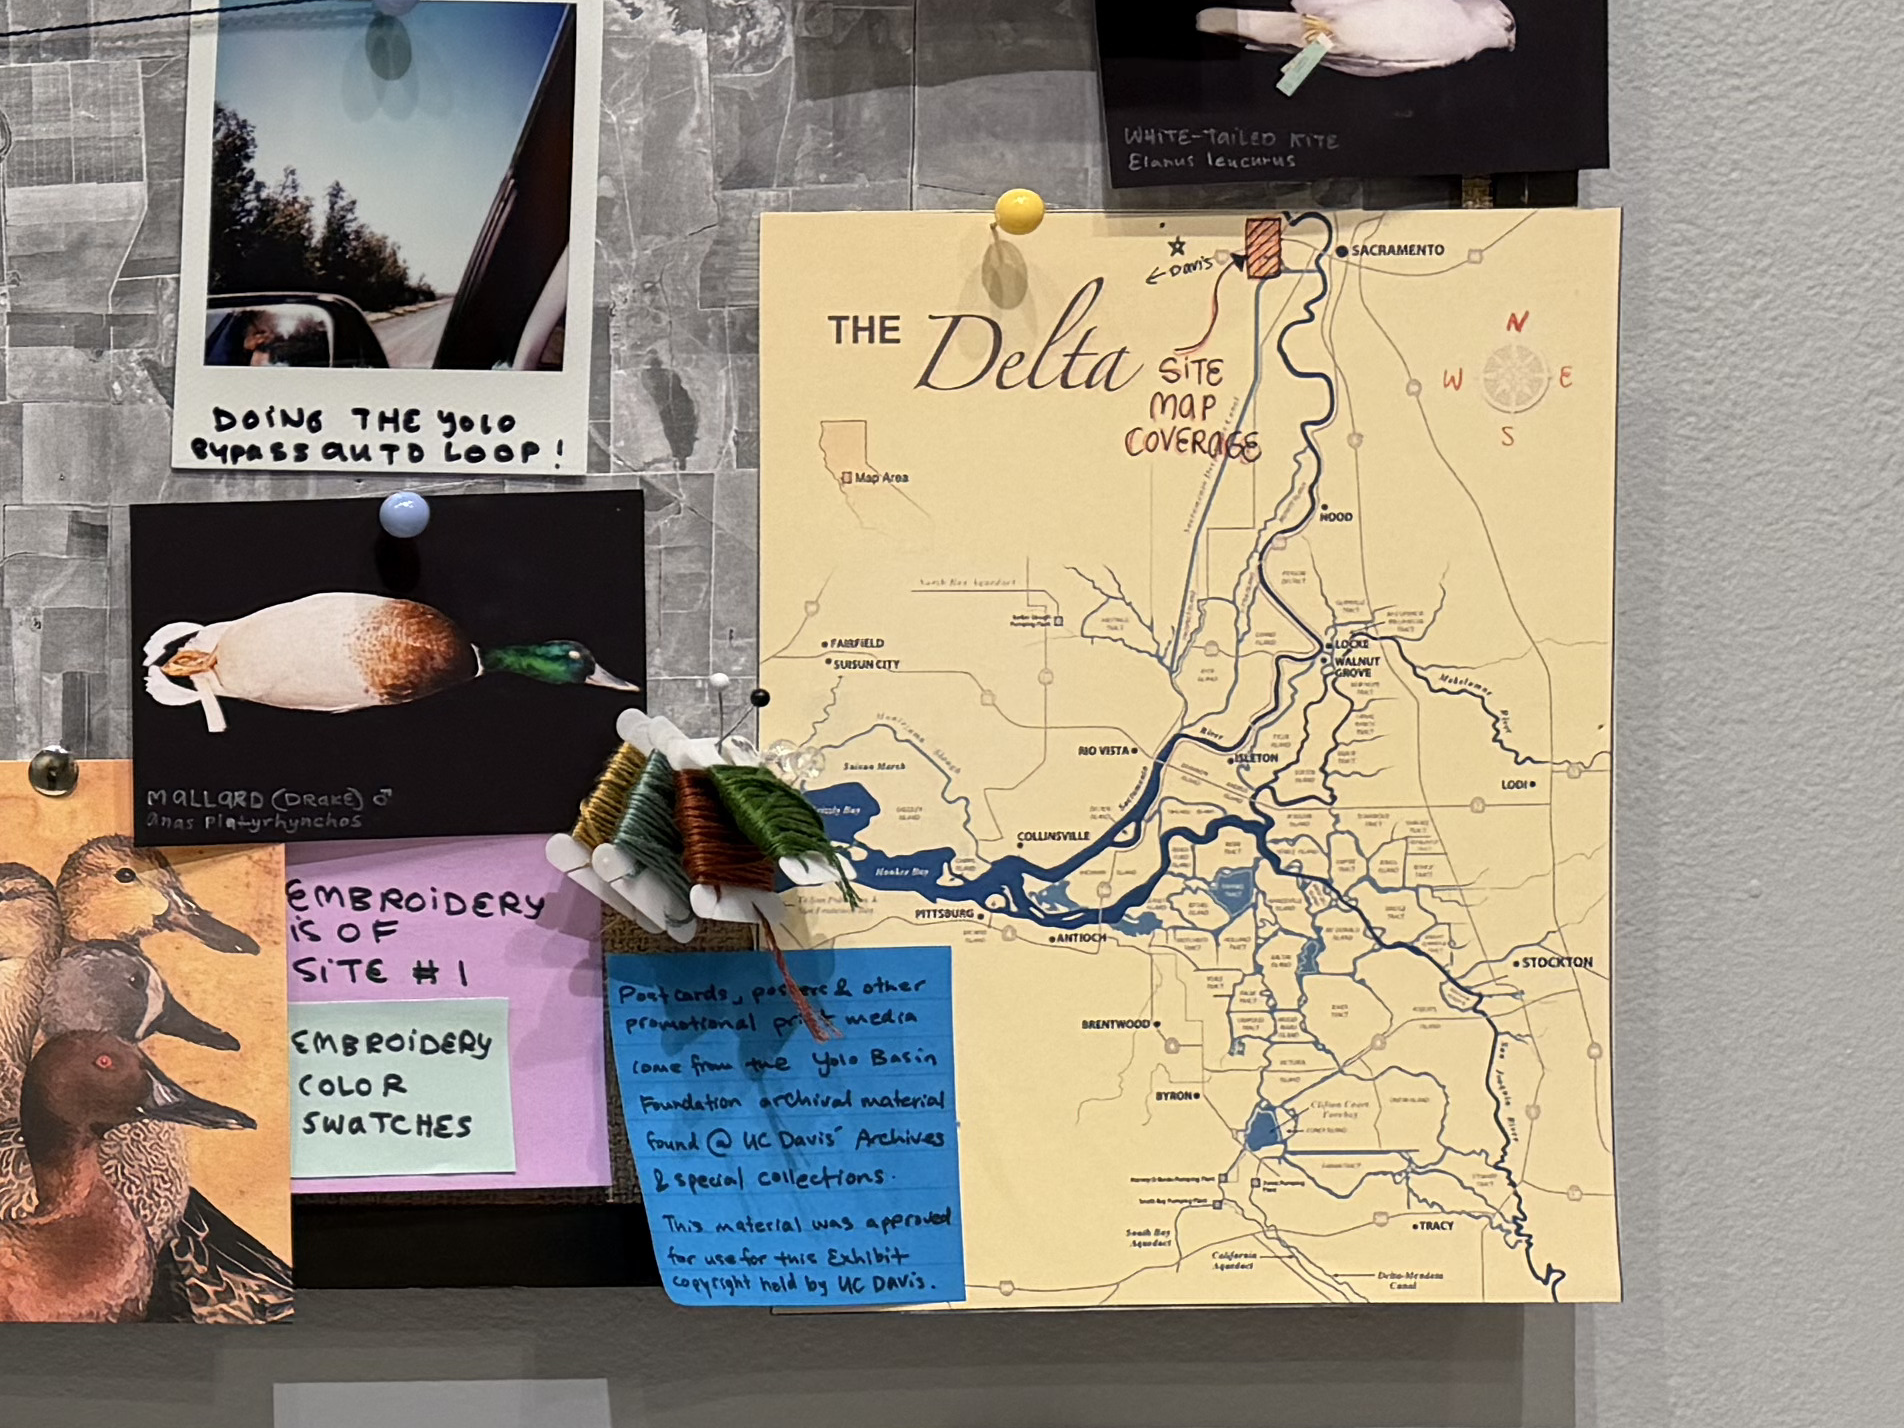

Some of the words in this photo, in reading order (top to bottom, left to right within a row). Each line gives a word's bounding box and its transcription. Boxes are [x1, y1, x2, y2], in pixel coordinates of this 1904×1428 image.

[1352, 244, 1444, 256] SACRAMENTO
[828, 315, 900, 344] THE
[914, 277, 1144, 391] Delta
[830, 638, 884, 652] FAIRFIELD
[1057, 934, 1107, 946] ANTIOCH
[1523, 955, 1594, 972] STOCKTON
